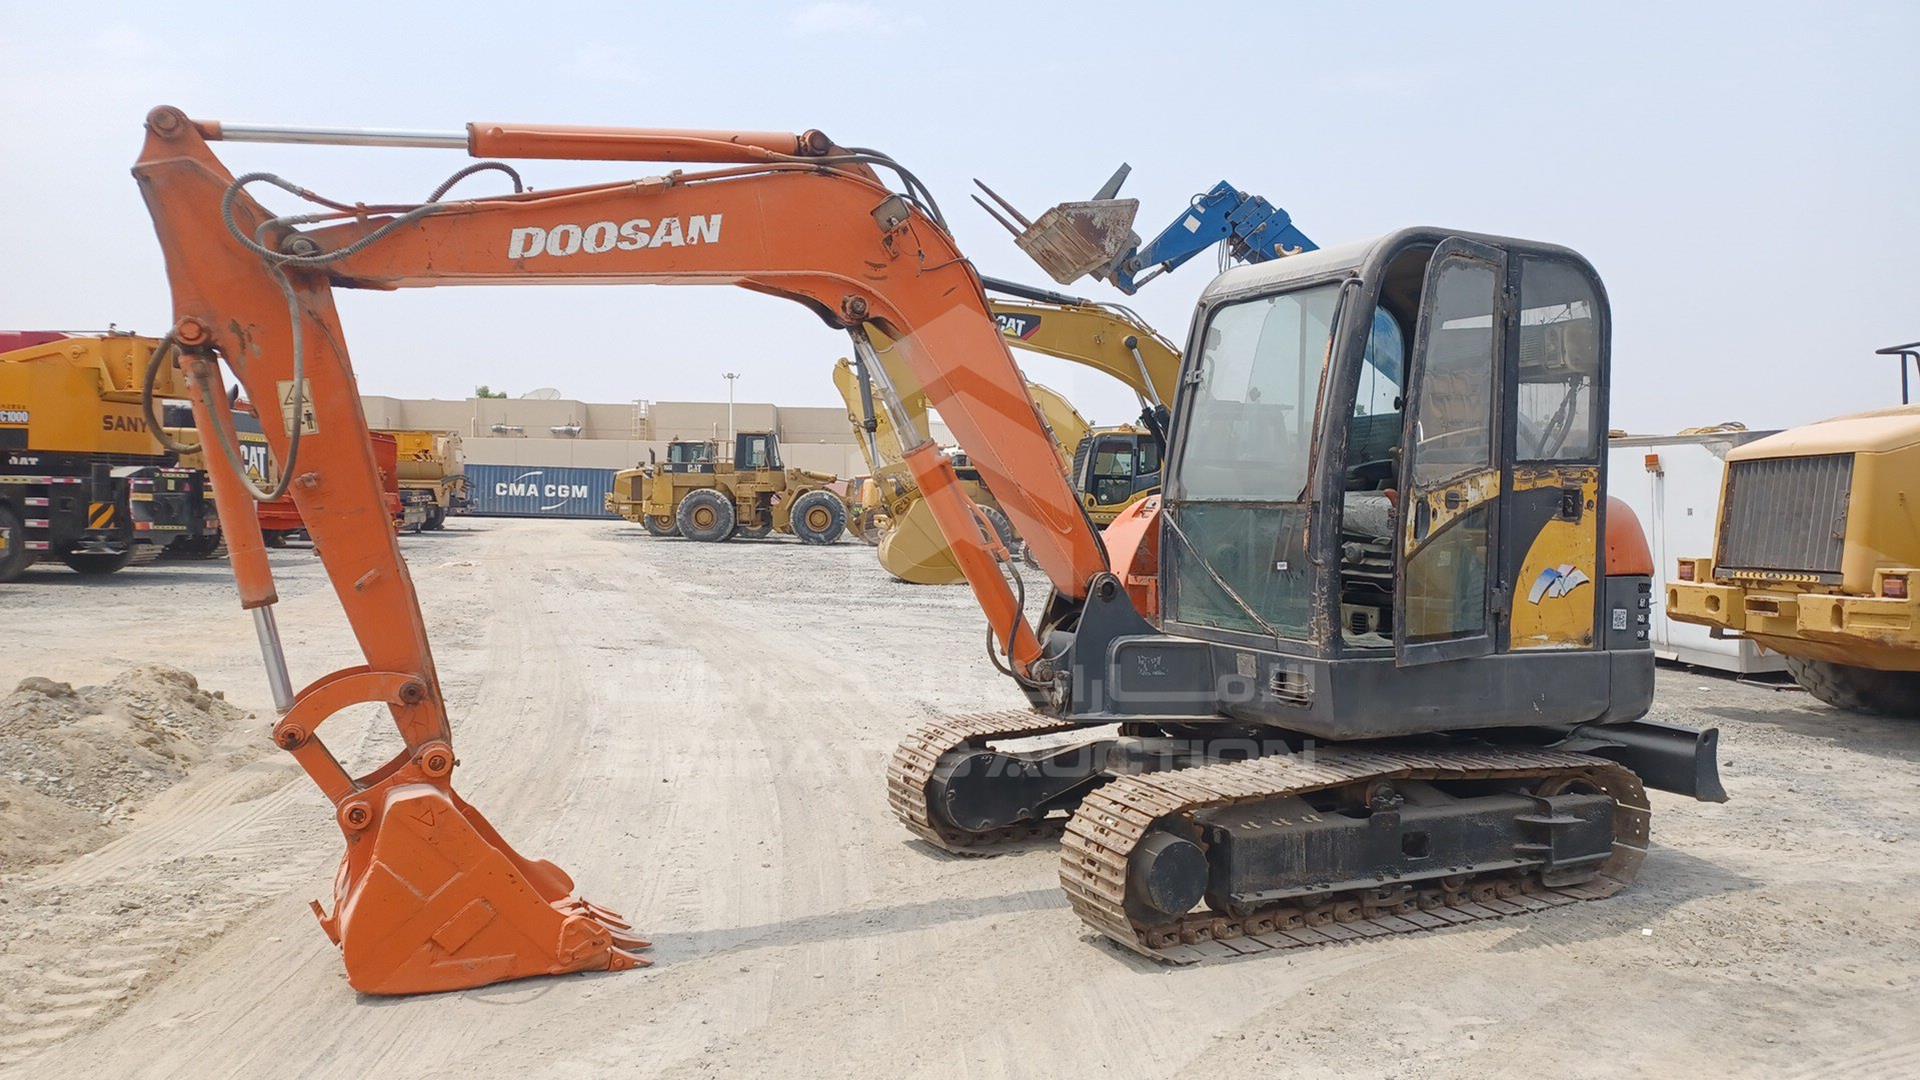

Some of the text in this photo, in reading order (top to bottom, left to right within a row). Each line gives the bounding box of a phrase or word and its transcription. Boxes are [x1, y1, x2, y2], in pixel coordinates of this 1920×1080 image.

[508, 213, 723, 260] DOOSAN
[995, 315, 1026, 337] CAT
[102, 415, 147, 433] SANY
[239, 445, 266, 481] CAT
[495, 482, 588, 498] CMA CGM
